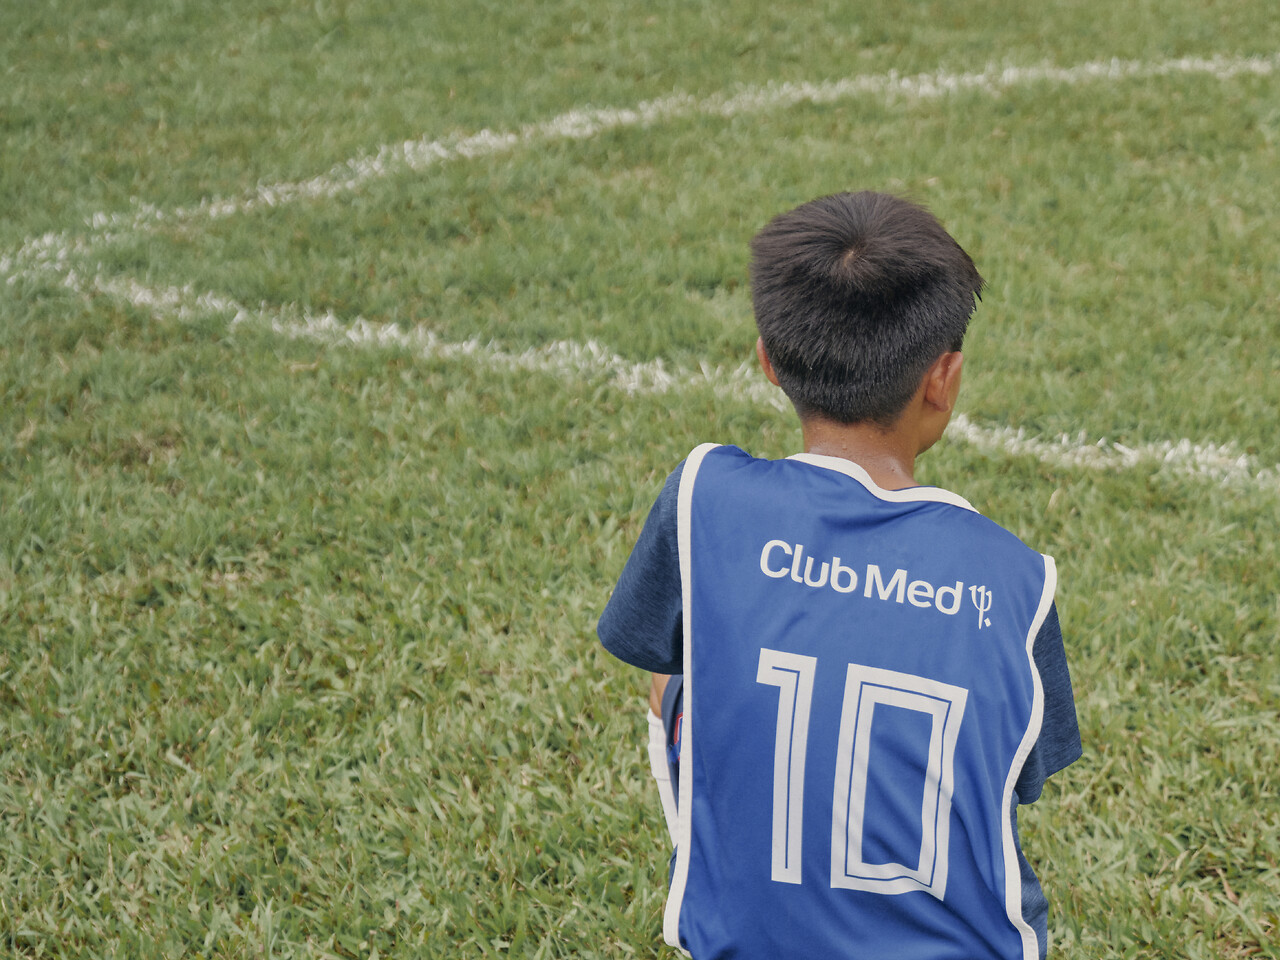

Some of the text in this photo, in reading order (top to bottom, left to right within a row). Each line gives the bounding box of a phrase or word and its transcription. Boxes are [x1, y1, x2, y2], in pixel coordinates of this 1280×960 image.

[760, 539, 964, 615] Club Med
[756, 648, 969, 901] 10
